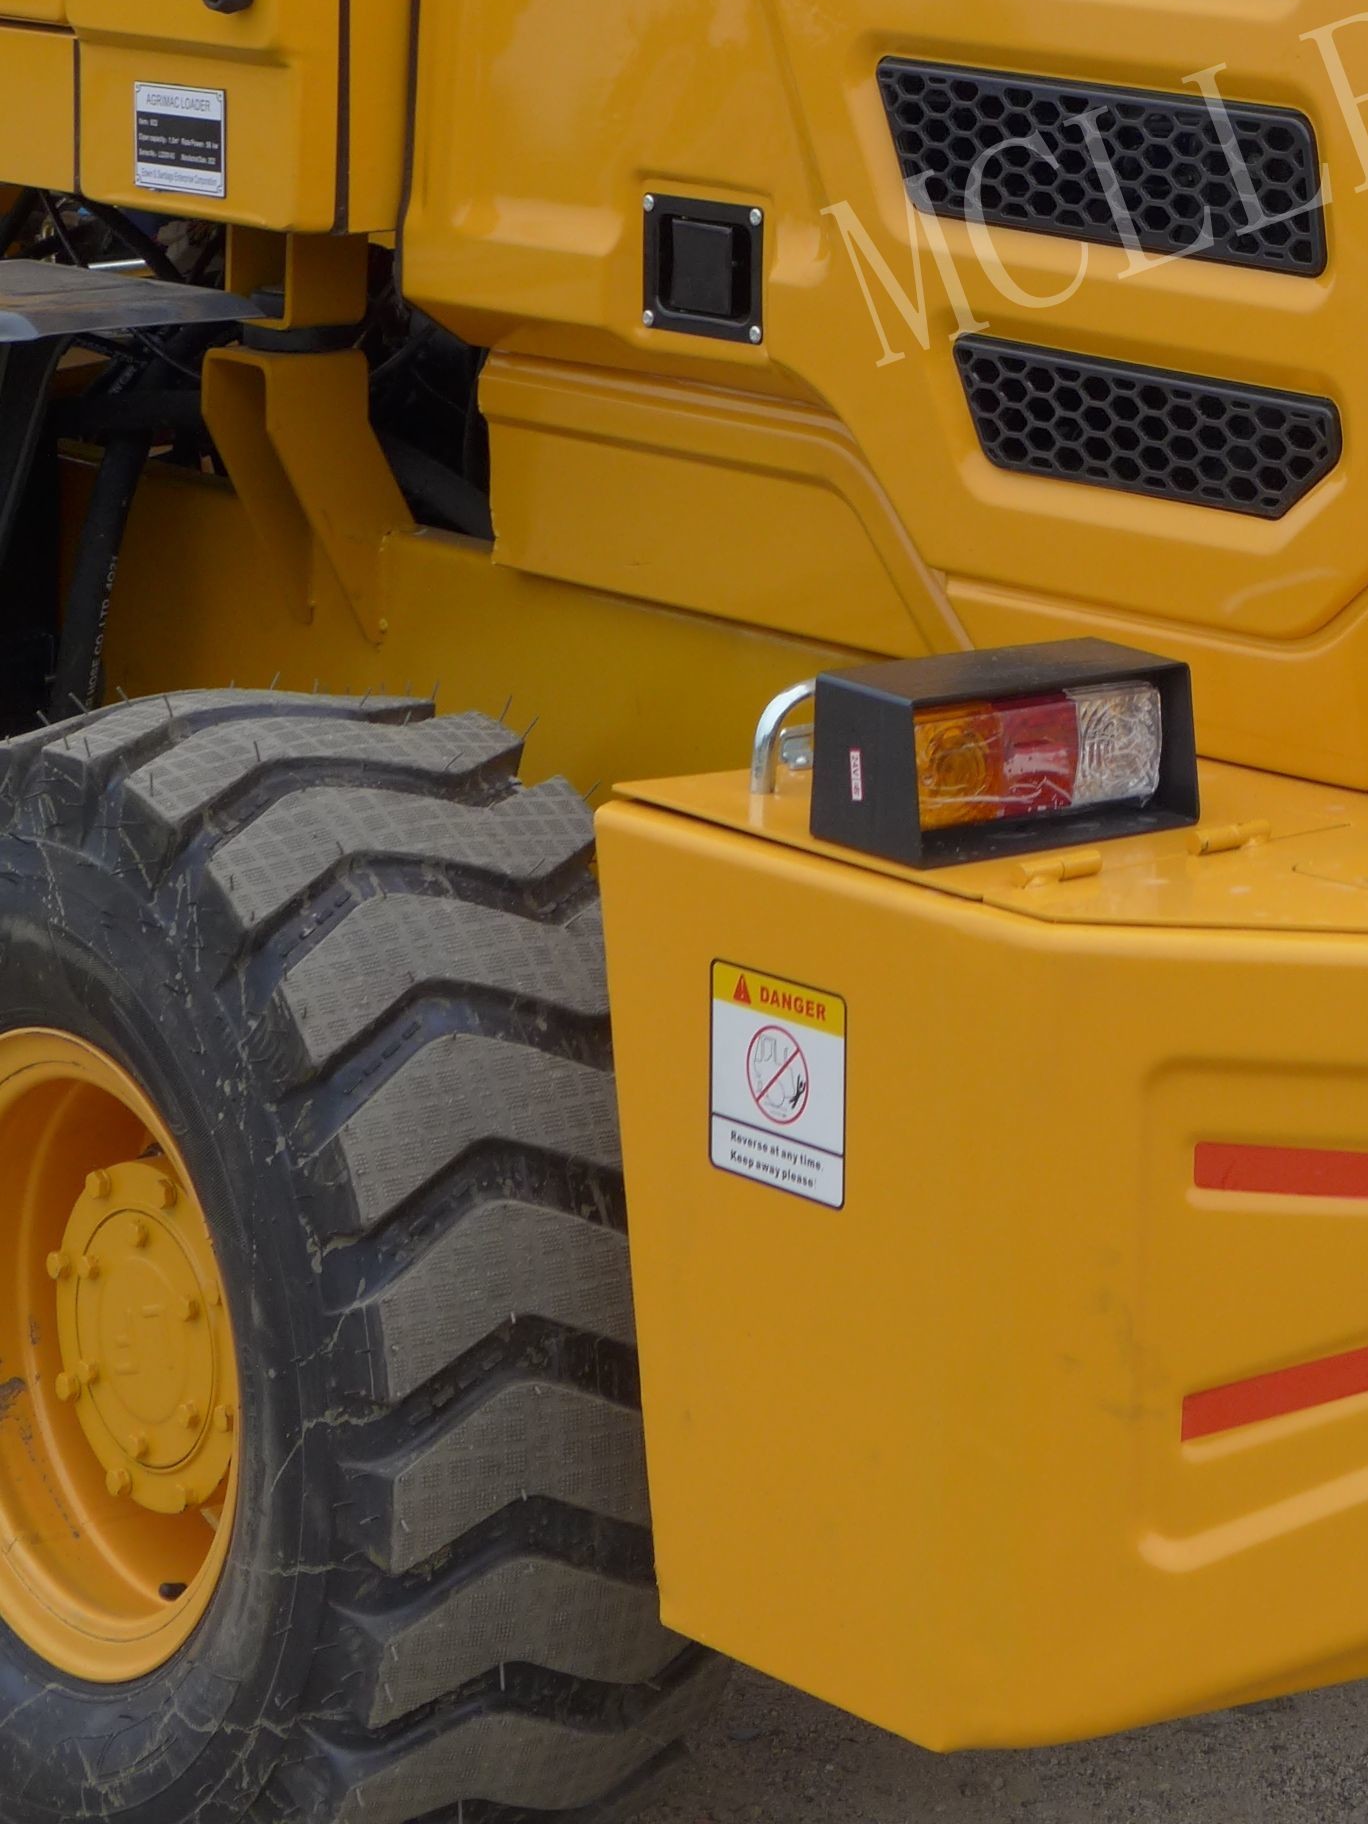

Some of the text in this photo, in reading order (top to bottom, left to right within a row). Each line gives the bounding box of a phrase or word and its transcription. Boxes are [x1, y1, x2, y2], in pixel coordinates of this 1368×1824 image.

[146, 93, 211, 112] AGRIMAC LOADER
[759, 985, 827, 1021] DANGER
[730, 1130, 768, 1154] Reverse
[770, 1144, 780, 1158] at
[781, 1150, 798, 1166] any
[730, 1149, 754, 1168] Keep
[756, 1160, 780, 1178] away
